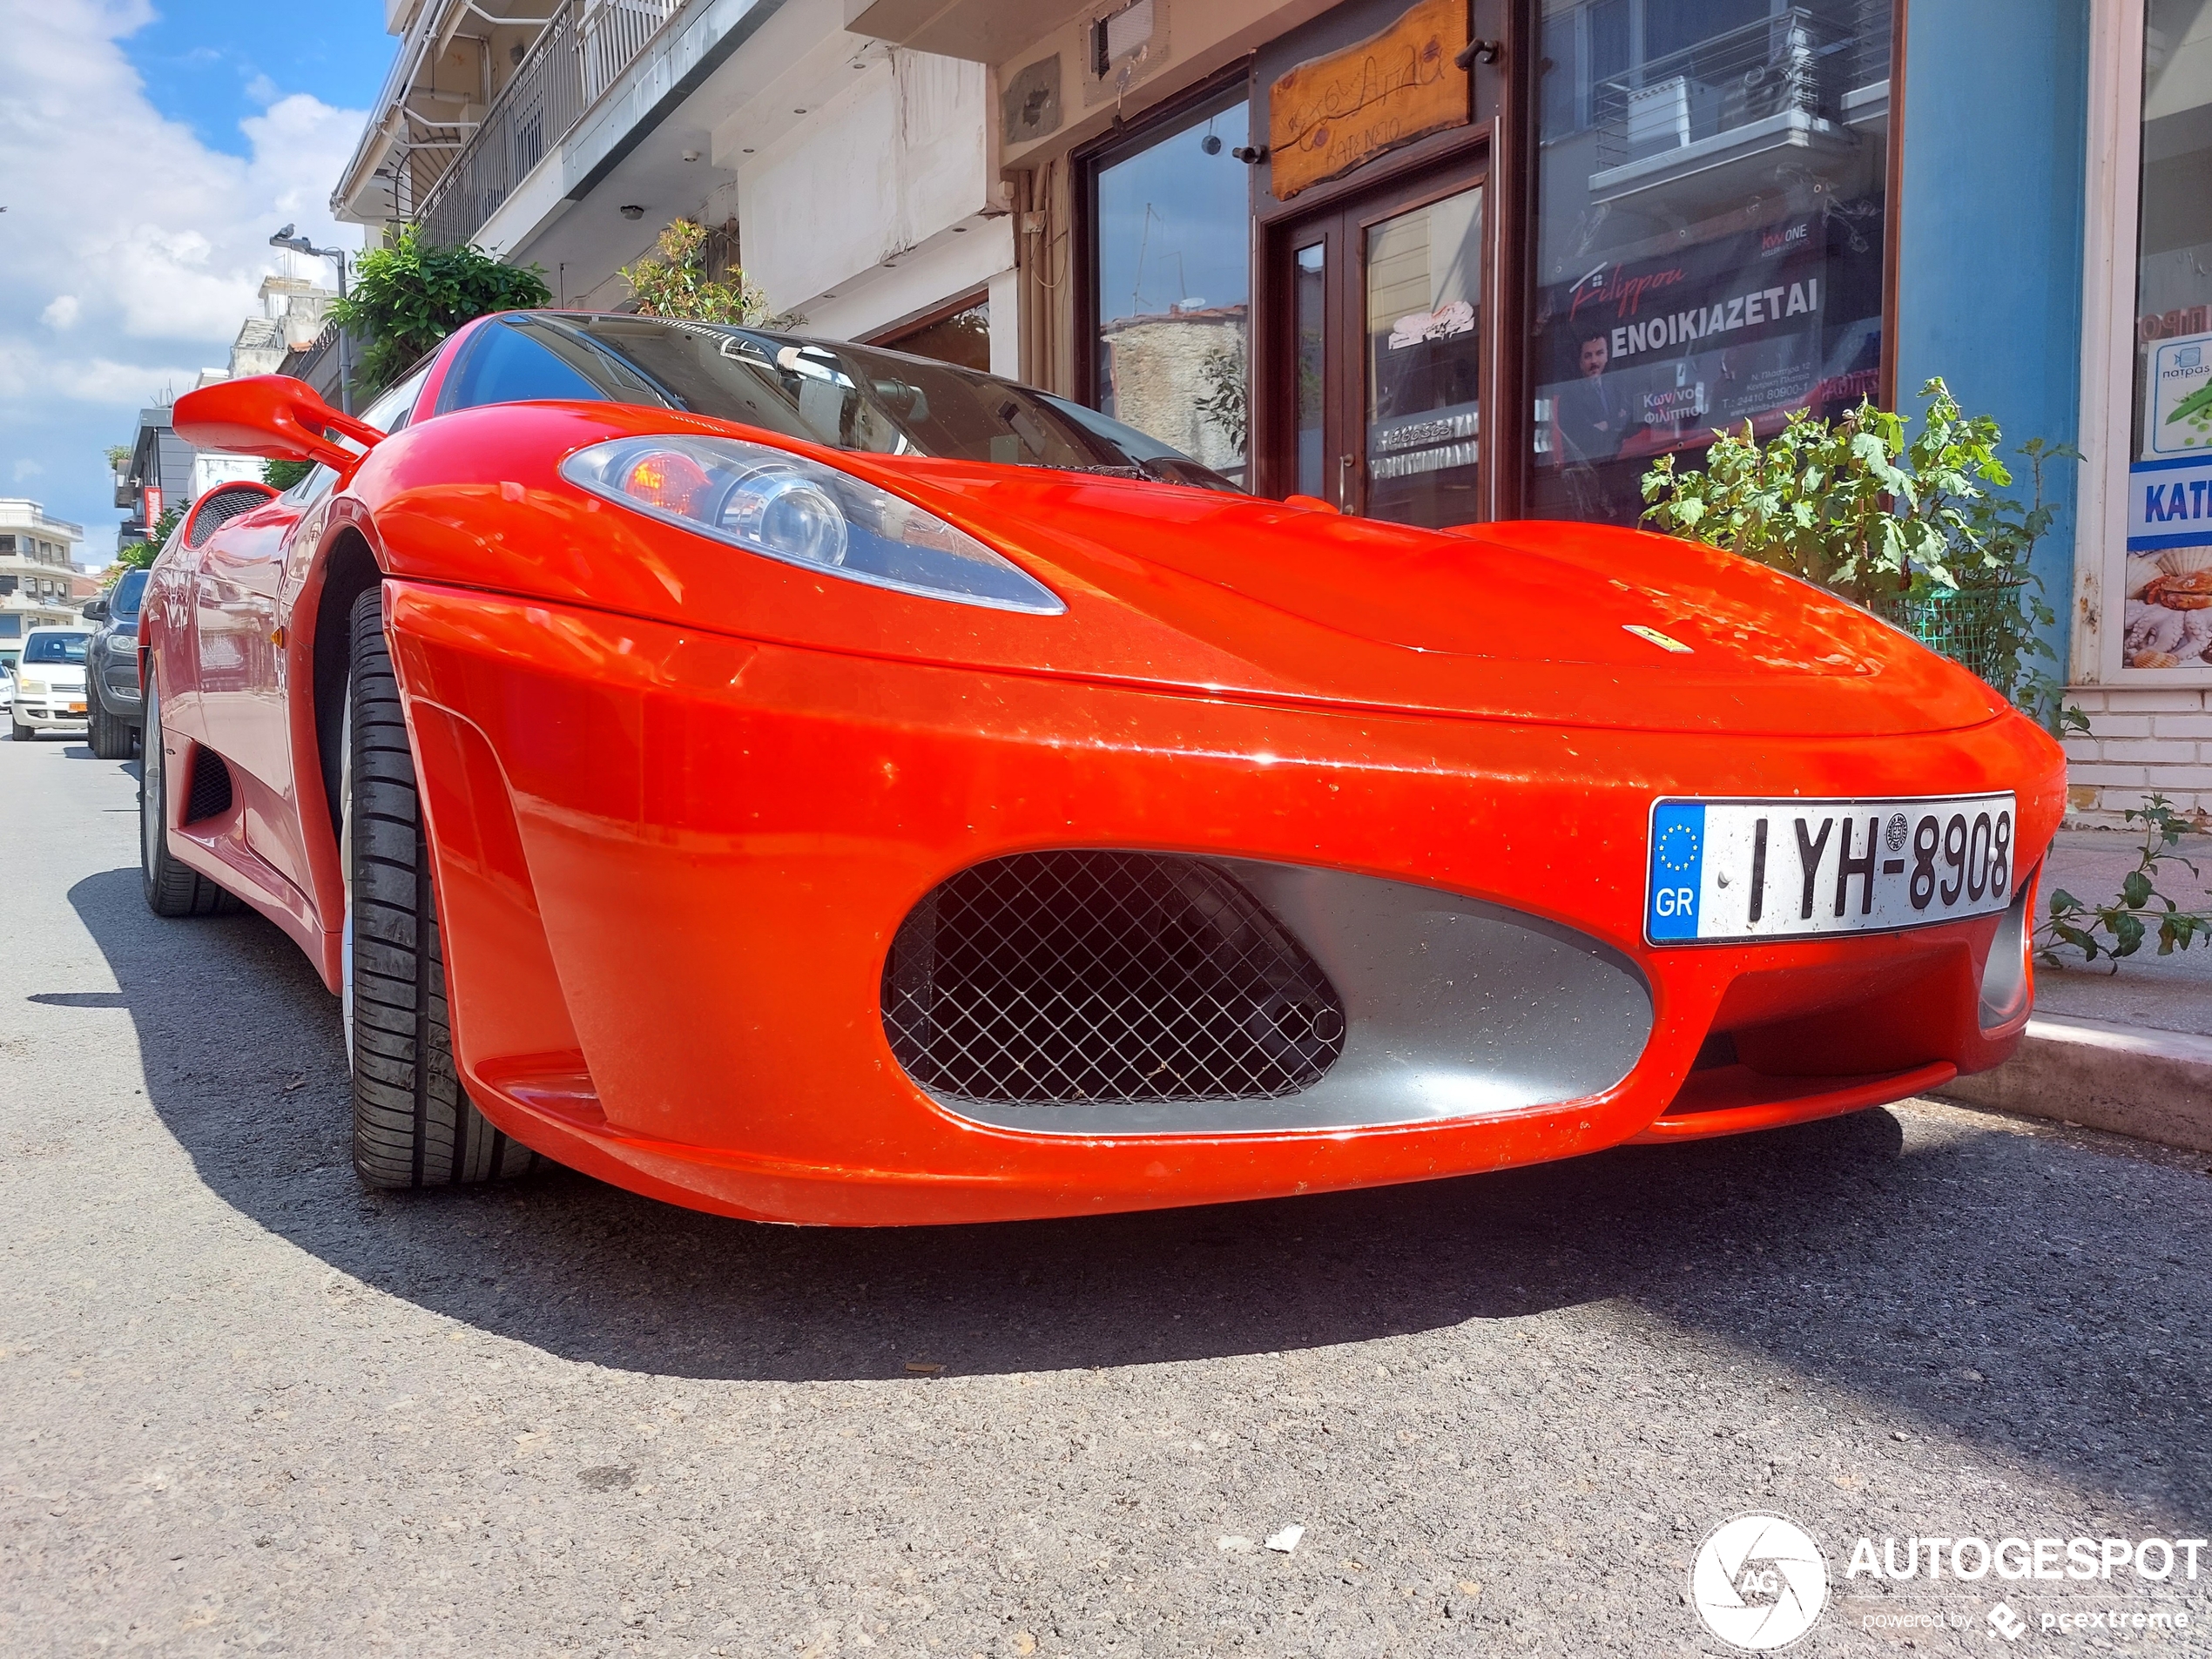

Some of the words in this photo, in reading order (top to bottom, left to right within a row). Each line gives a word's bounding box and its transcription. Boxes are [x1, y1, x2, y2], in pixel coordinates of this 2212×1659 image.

[1785, 224, 1807, 241] ONE
[1611, 279, 1817, 358] ΕΝΟΙΚΙΑΖΕΤΑΙ
[1643, 388, 1703, 408] Κων/νος
[1767, 382, 1808, 400] 80900-1
[1644, 403, 1710, 424] Φιλίππου
[1656, 887, 1694, 916] GR
